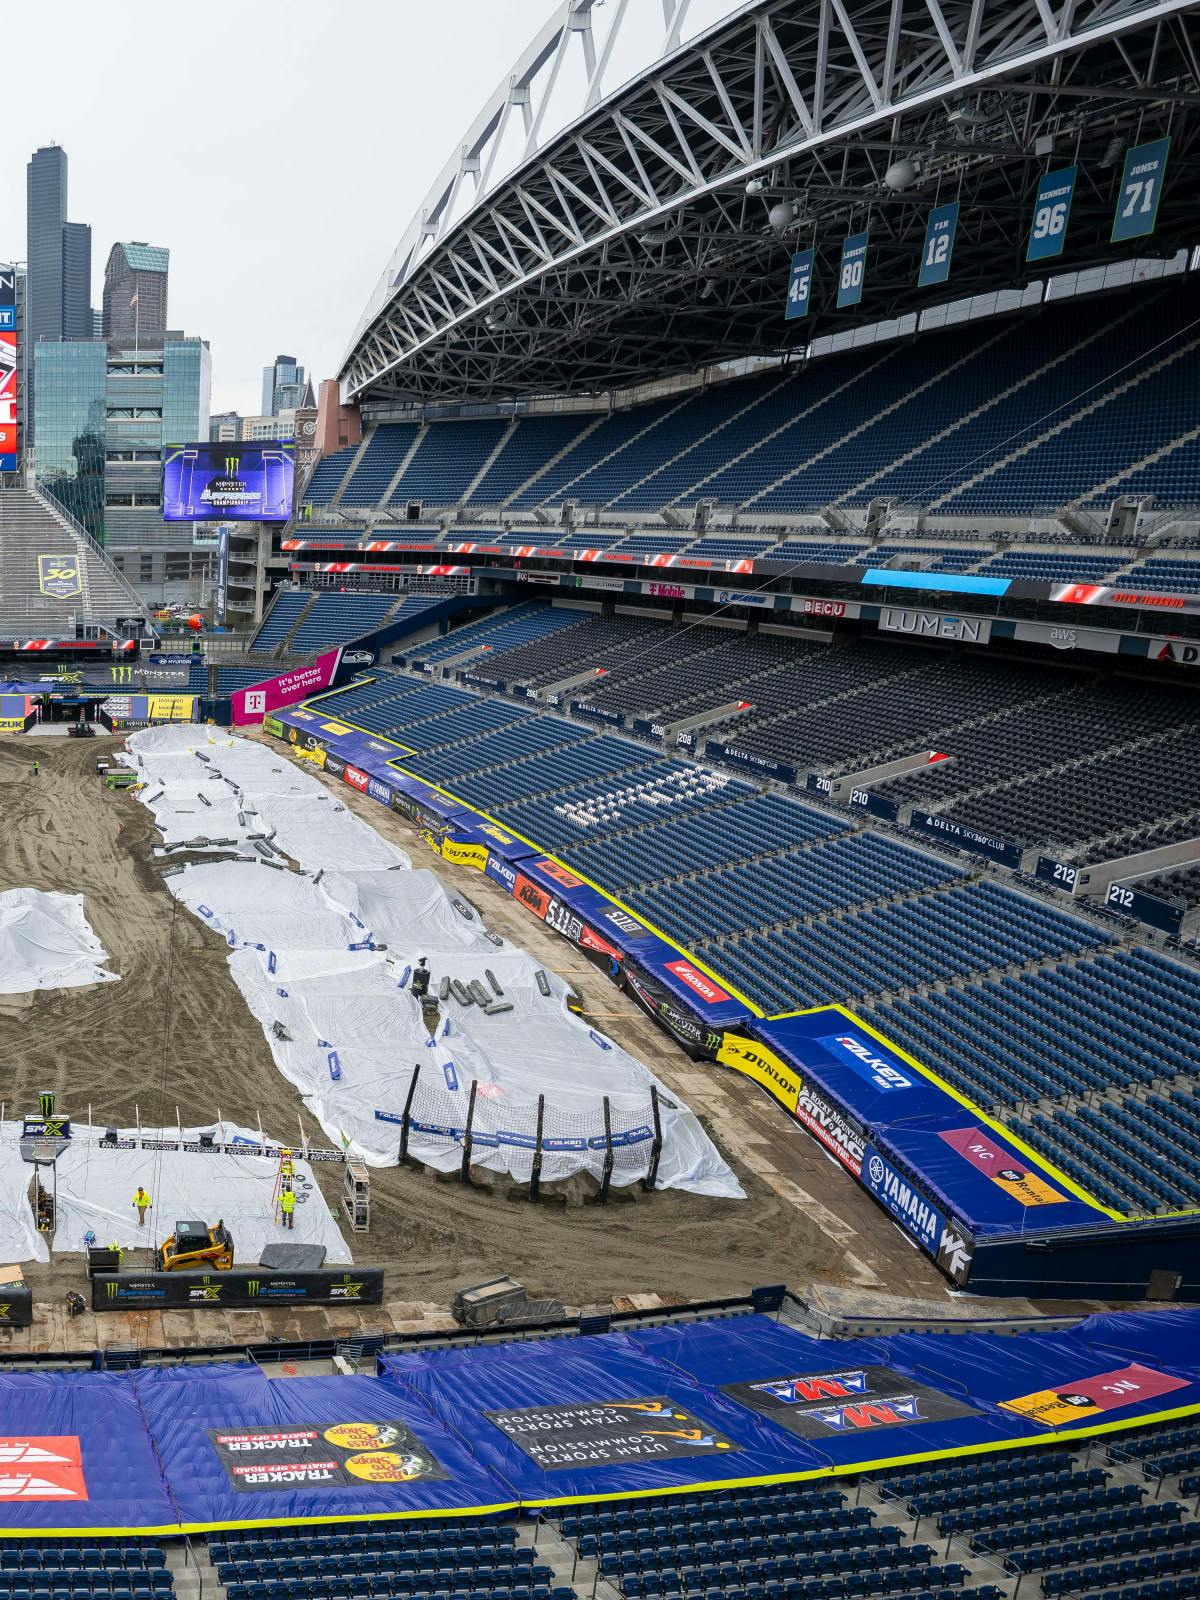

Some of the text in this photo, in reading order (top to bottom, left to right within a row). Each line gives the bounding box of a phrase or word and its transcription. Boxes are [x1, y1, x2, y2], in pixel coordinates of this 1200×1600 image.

[1130, 161, 1159, 177] JONES
[1039, 185, 1071, 201] KENNEDY
[1122, 178, 1154, 217] 71
[934, 220, 949, 231] FAN
[1034, 204, 1066, 239] 96
[925, 234, 949, 267] 12
[840, 261, 863, 289] 80
[789, 277, 809, 302] 45
[43, 568, 76, 581] 30
[804, 601, 844, 616] BECU
[885, 610, 981, 641] LUMEN
[1050, 627, 1076, 641] aws
[134, 668, 185, 677] MONSTER
[278, 666, 322, 687] It's better
[281, 674, 322, 694] over here
[249, 695, 261, 710] T
[582, 703, 597, 713] DELTA
[651, 724, 664, 737] 208
[678, 732, 692, 745] 208
[730, 749, 749, 761] DELTA
[346, 768, 368, 785] FLY
[816, 777, 831, 792] 210
[852, 790, 868, 806] 210
[934, 818, 960, 835] DELTA
[449, 849, 487, 863] DUNLOP
[489, 857, 516, 883] FALKEN
[1053, 863, 1076, 884] 212
[519, 884, 543, 911] KTM
[1109, 885, 1135, 908] 212
[684, 973, 715, 999] HONDA
[835, 1036, 913, 1089] FALKEN
[741, 1050, 797, 1097] DUNLOP
[810, 1091, 867, 1150] ROCKY MOUNTAIN
[25, 1122, 63, 1136] SMX
[549, 1139, 582, 1147] FALKEN
[968, 1144, 994, 1160] NC
[883, 1167, 938, 1239] YAMAHA
[869, 1179, 931, 1246] RACING
[189, 1287, 222, 1300] SMX
[329, 1285, 362, 1298] SMX
[1102, 1379, 1141, 1395] NC
[496, 1407, 617, 1425] COMMISSION
[504, 1413, 630, 1434] UTAH SPORTS
[281, 1431, 315, 1439] BOATS
[329, 1426, 368, 1435] Shops
[228, 1437, 313, 1451] TRACKER
[349, 1439, 380, 1449] Bass
[529, 1435, 655, 1454] COMMISSION
[351, 1456, 391, 1465] Shops
[537, 1442, 670, 1464] UTAH SPORTS
[235, 1466, 260, 1474] ROAD
[298, 1461, 336, 1470] BOATS
[244, 1468, 334, 1484] TRACKER
[368, 1471, 404, 1481] Bass
